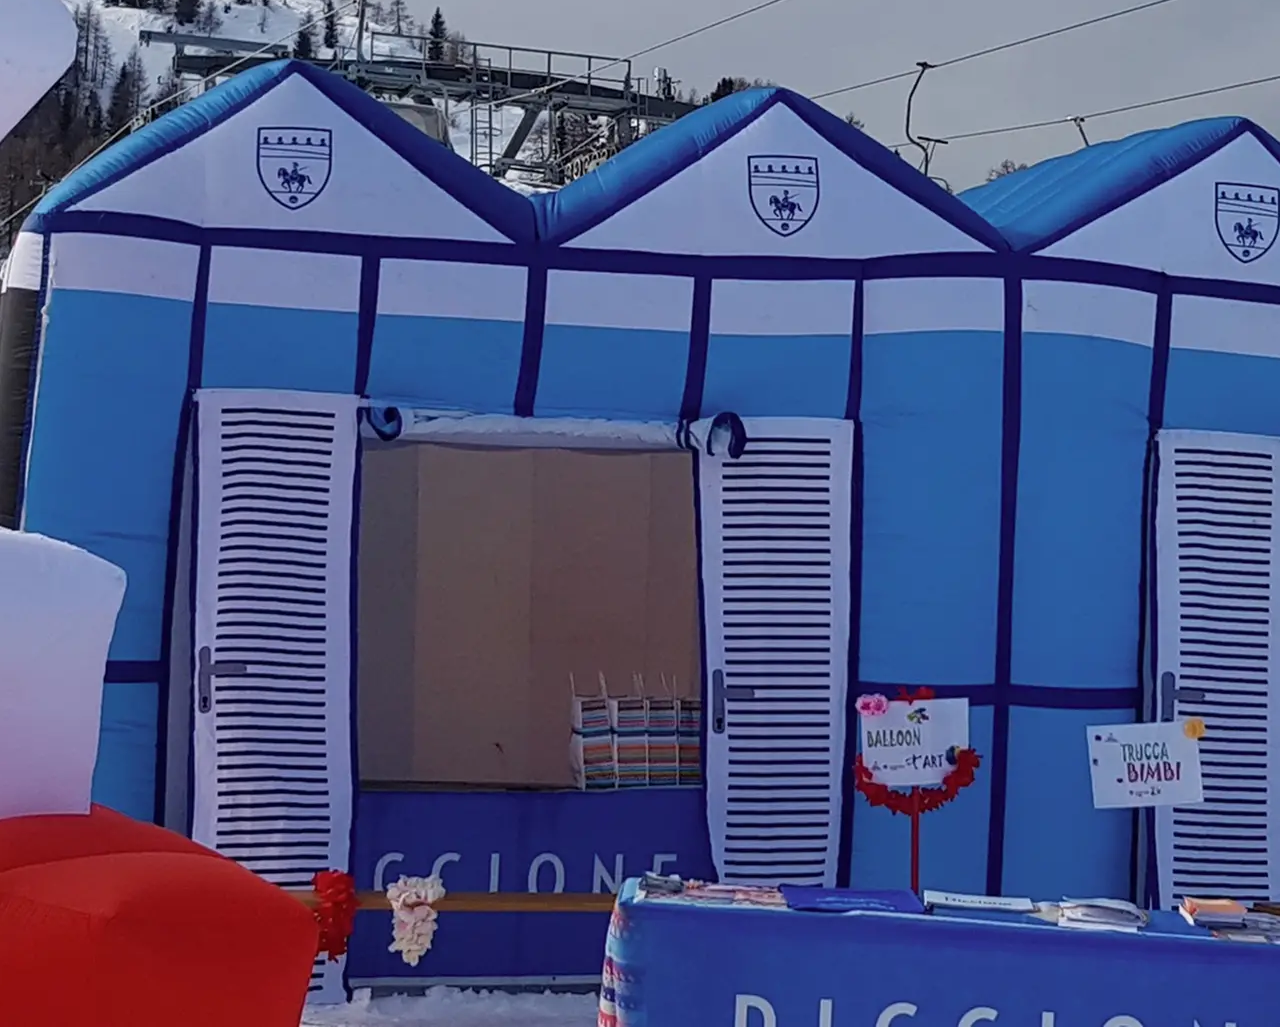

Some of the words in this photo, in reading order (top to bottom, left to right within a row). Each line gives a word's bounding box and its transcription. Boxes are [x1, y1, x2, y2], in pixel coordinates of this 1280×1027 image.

[867, 728, 921, 748] BALLOON
[1121, 742, 1169, 762] TRUCCA
[1126, 761, 1181, 784] BIMBI
